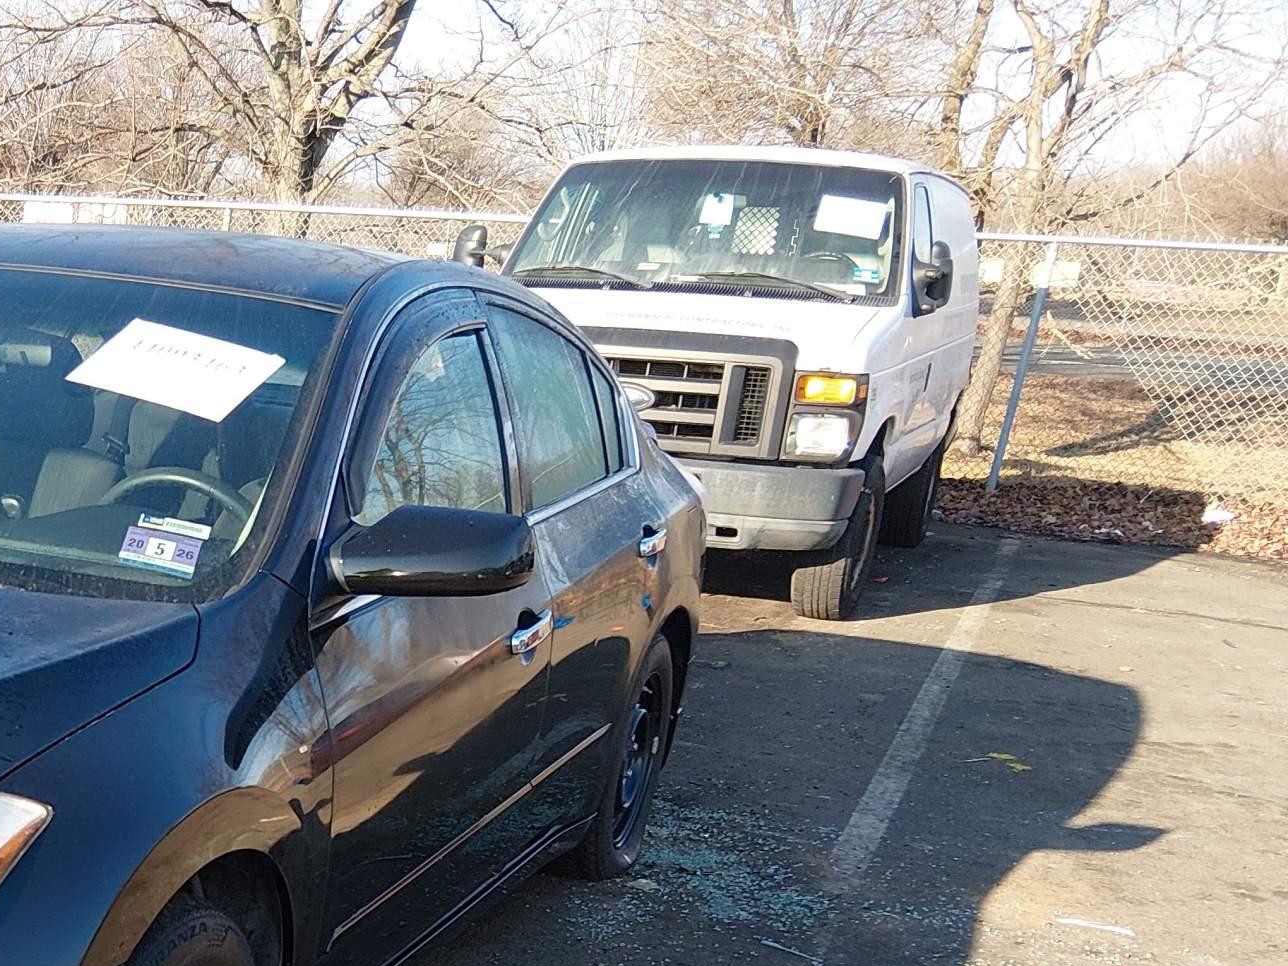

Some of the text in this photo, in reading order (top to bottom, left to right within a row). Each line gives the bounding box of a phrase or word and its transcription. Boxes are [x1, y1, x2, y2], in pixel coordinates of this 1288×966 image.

[127, 537, 145, 549] 20
[154, 542, 166, 556] 5
[176, 548, 194, 560] 26
